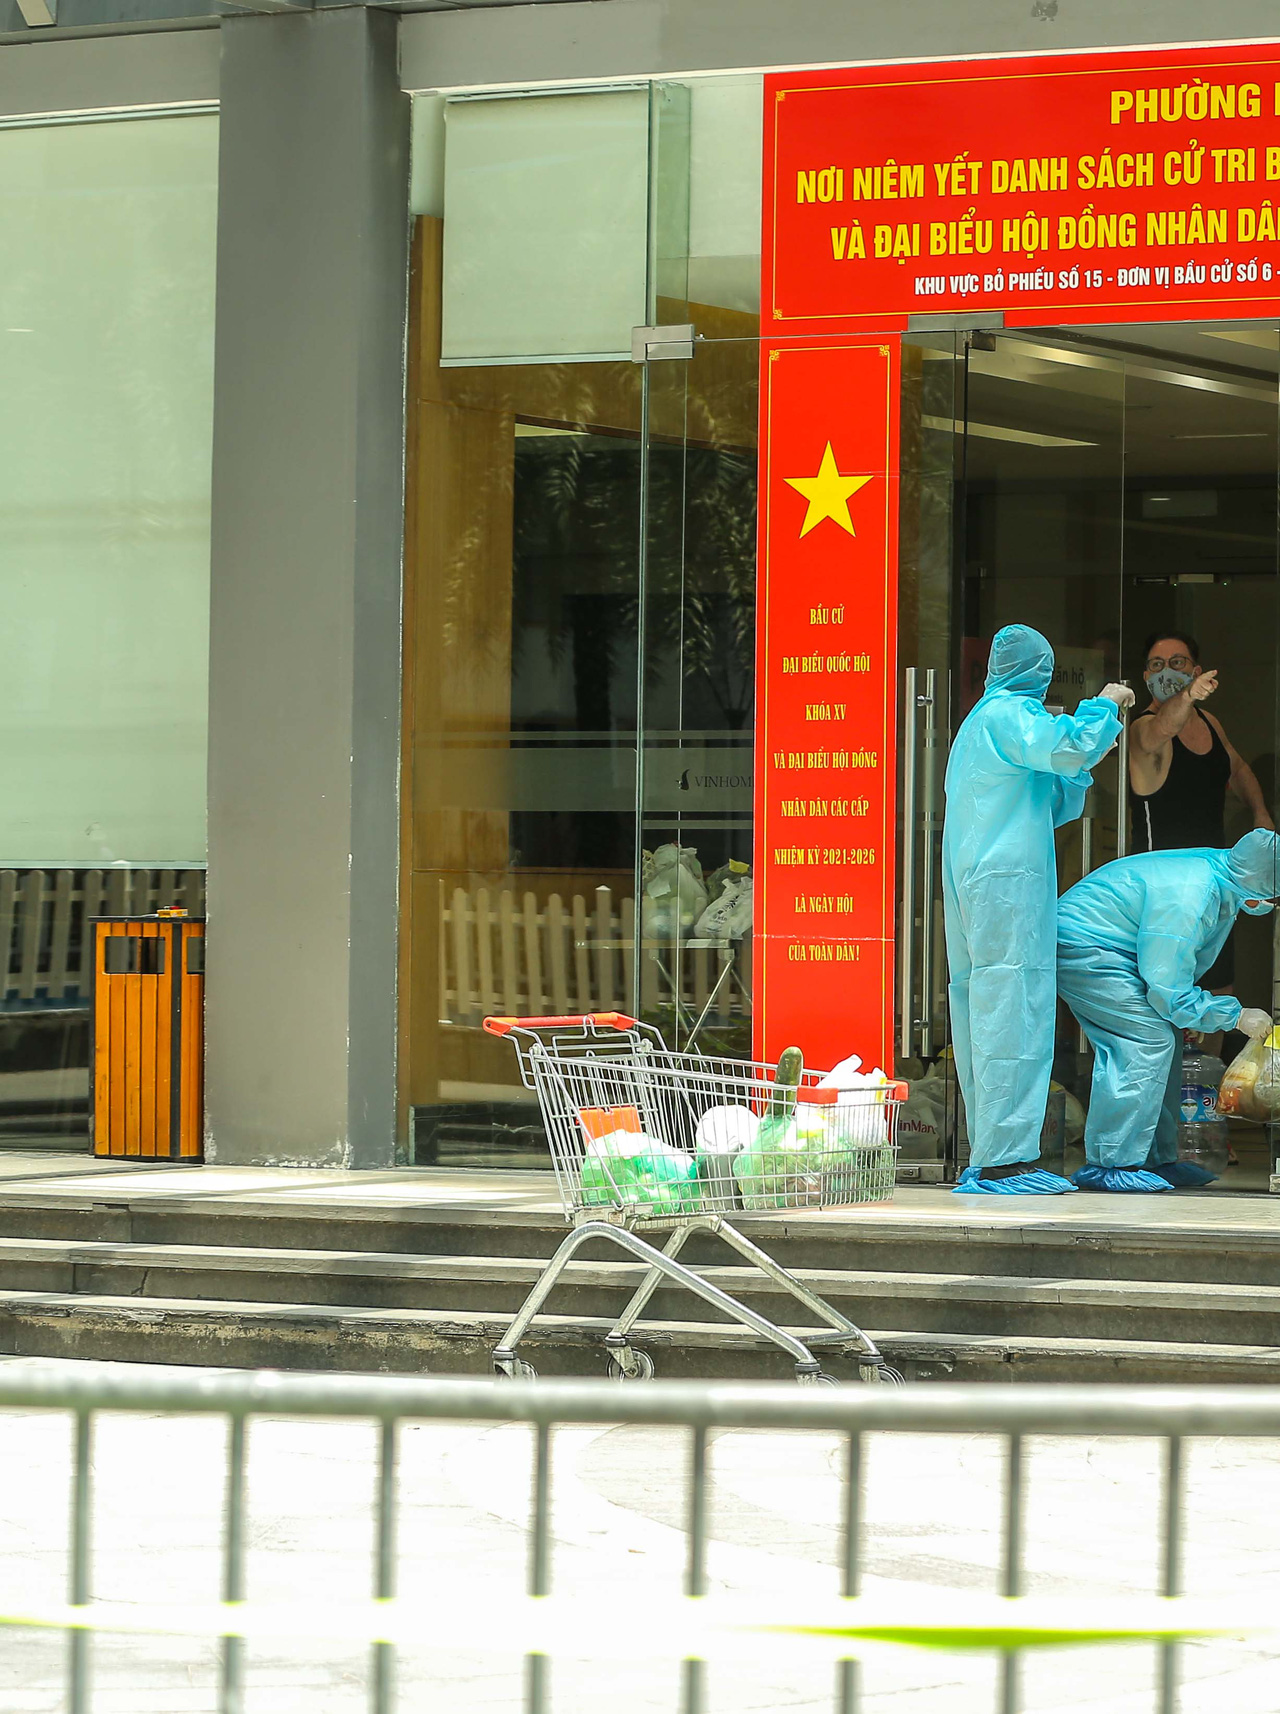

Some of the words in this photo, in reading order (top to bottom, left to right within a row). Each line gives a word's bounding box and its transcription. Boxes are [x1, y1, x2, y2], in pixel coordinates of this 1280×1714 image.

[1110, 77, 1261, 125] PHƯỜNG
[796, 165, 844, 204] NƠI
[853, 158, 925, 201] NIÊM
[933, 150, 983, 197] YẾT
[991, 156, 1068, 194] DANH
[1077, 147, 1154, 190] SÁCH
[1163, 138, 1206, 186] CỬ
[1210, 147, 1256, 183] TRI
[830, 219, 866, 260] VÀ
[873, 223, 920, 265] ĐẠI
[929, 206, 993, 256] BIỂU
[1002, 210, 1049, 259] HỘI
[1057, 203, 1137, 250] ĐỒNG
[1146, 202, 1228, 246] NHÂN
[914, 276, 946, 295] KHU
[949, 273, 980, 297] VỰC
[983, 267, 1005, 293] BỎ
[1008, 266, 1054, 292] PHIẾU
[1058, 264, 1080, 290] SỐ
[1083, 269, 1103, 288] 15
[1117, 266, 1151, 287] ĐƠN
[1154, 266, 1170, 289] VỊ
[1174, 259, 1206, 285] BẦU
[1210, 258, 1234, 283] CỬ
[1236, 256, 1258, 282] SỐ
[1262, 262, 1272, 282] 6
[809, 602, 830, 625] BẦU
[831, 603, 845, 625] CỬ
[782, 656, 799, 675] ĐẠI
[801, 650, 824, 673] BIỂU
[826, 650, 851, 674] QUỐC
[853, 651, 871, 675] HỘI
[1071, 667, 1085, 689] hộ
[805, 700, 832, 721] KHÓA
[833, 703, 847, 721] XV
[773, 749, 786, 769] VÀ
[788, 752, 805, 772] ĐẠI
[807, 746, 830, 769] BIỂU
[832, 748, 849, 772] HỘI
[851, 746, 878, 769] ĐỒNG
[694, 775, 753, 788] VINHOM
[780, 796, 807, 817] NHÂN
[808, 796, 829, 817] DÂN
[830, 796, 849, 817] CÁC
[850, 794, 870, 817] CẤP
[774, 844, 805, 868] NHIỆM
[807, 844, 821, 865] KỲ
[822, 848, 875, 865] 2021-2026
[794, 892, 807, 913] LÀ
[808, 892, 835, 913] NGÀY
[836, 892, 854, 916] HỘI
[788, 940, 807, 962] CỦA
[808, 941, 834, 962] TOÀN
[835, 941, 860, 962] DÂN!
